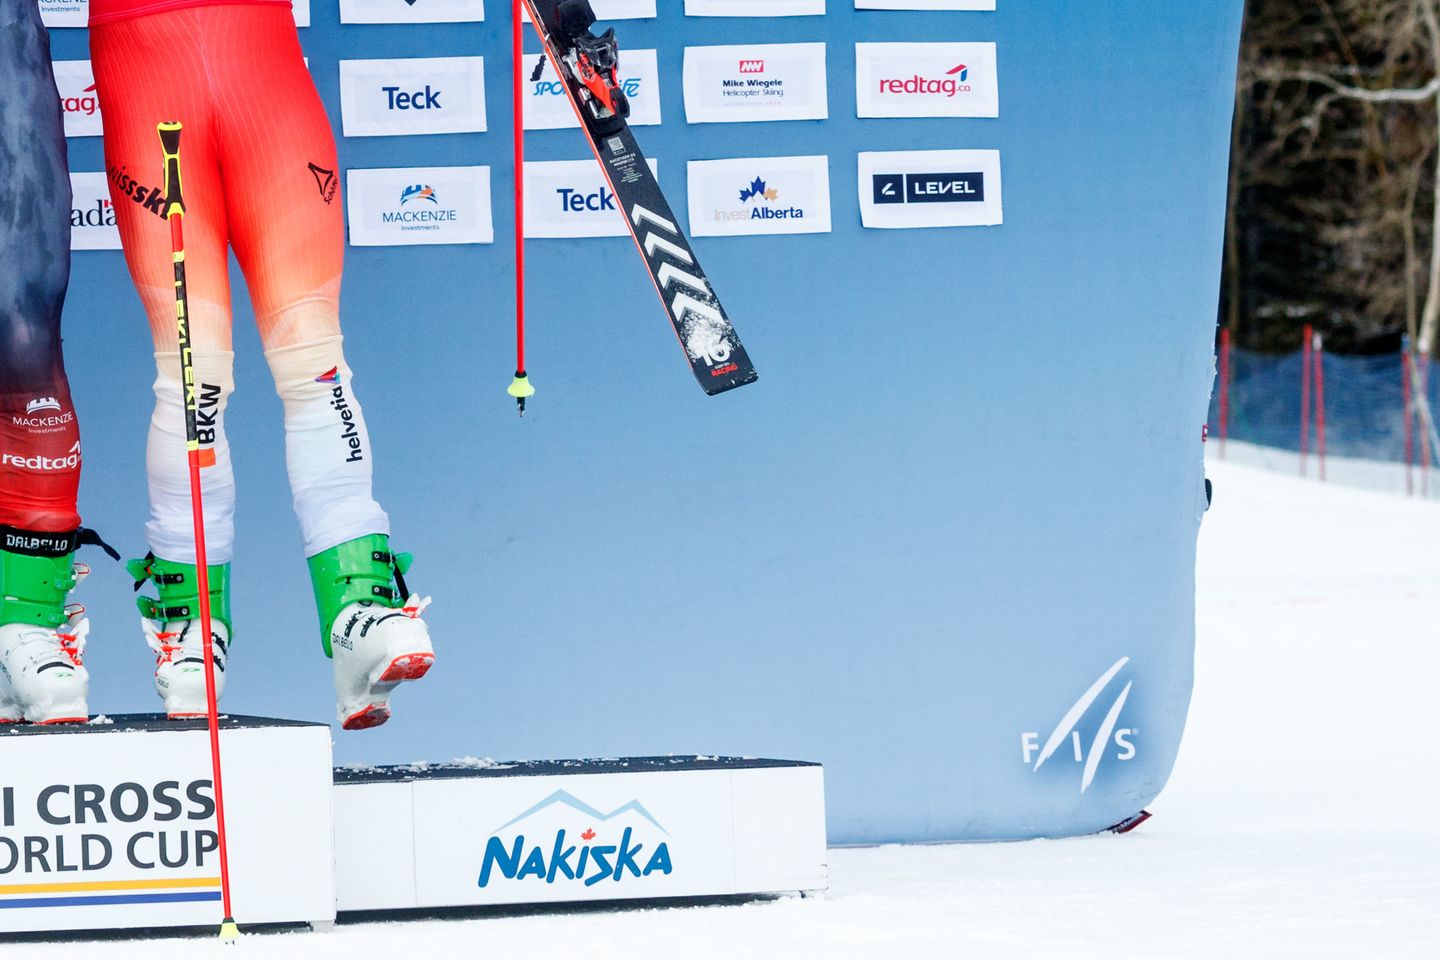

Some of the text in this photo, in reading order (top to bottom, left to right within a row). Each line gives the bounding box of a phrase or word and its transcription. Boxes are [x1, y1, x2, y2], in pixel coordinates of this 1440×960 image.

[723, 89, 762, 97] Helicopter
[747, 79, 782, 88] Wiegele
[880, 74, 970, 97] redtag.ca
[382, 85, 441, 110] Teck
[915, 181, 975, 194] LEVEL
[383, 210, 456, 222] MACKENZIE
[196, 382, 222, 445] BKW
[332, 385, 363, 464] helvetia
[1022, 730, 1135, 763] FIS
[36, 779, 216, 824] CROSS
[126, 829, 220, 869] CUP
